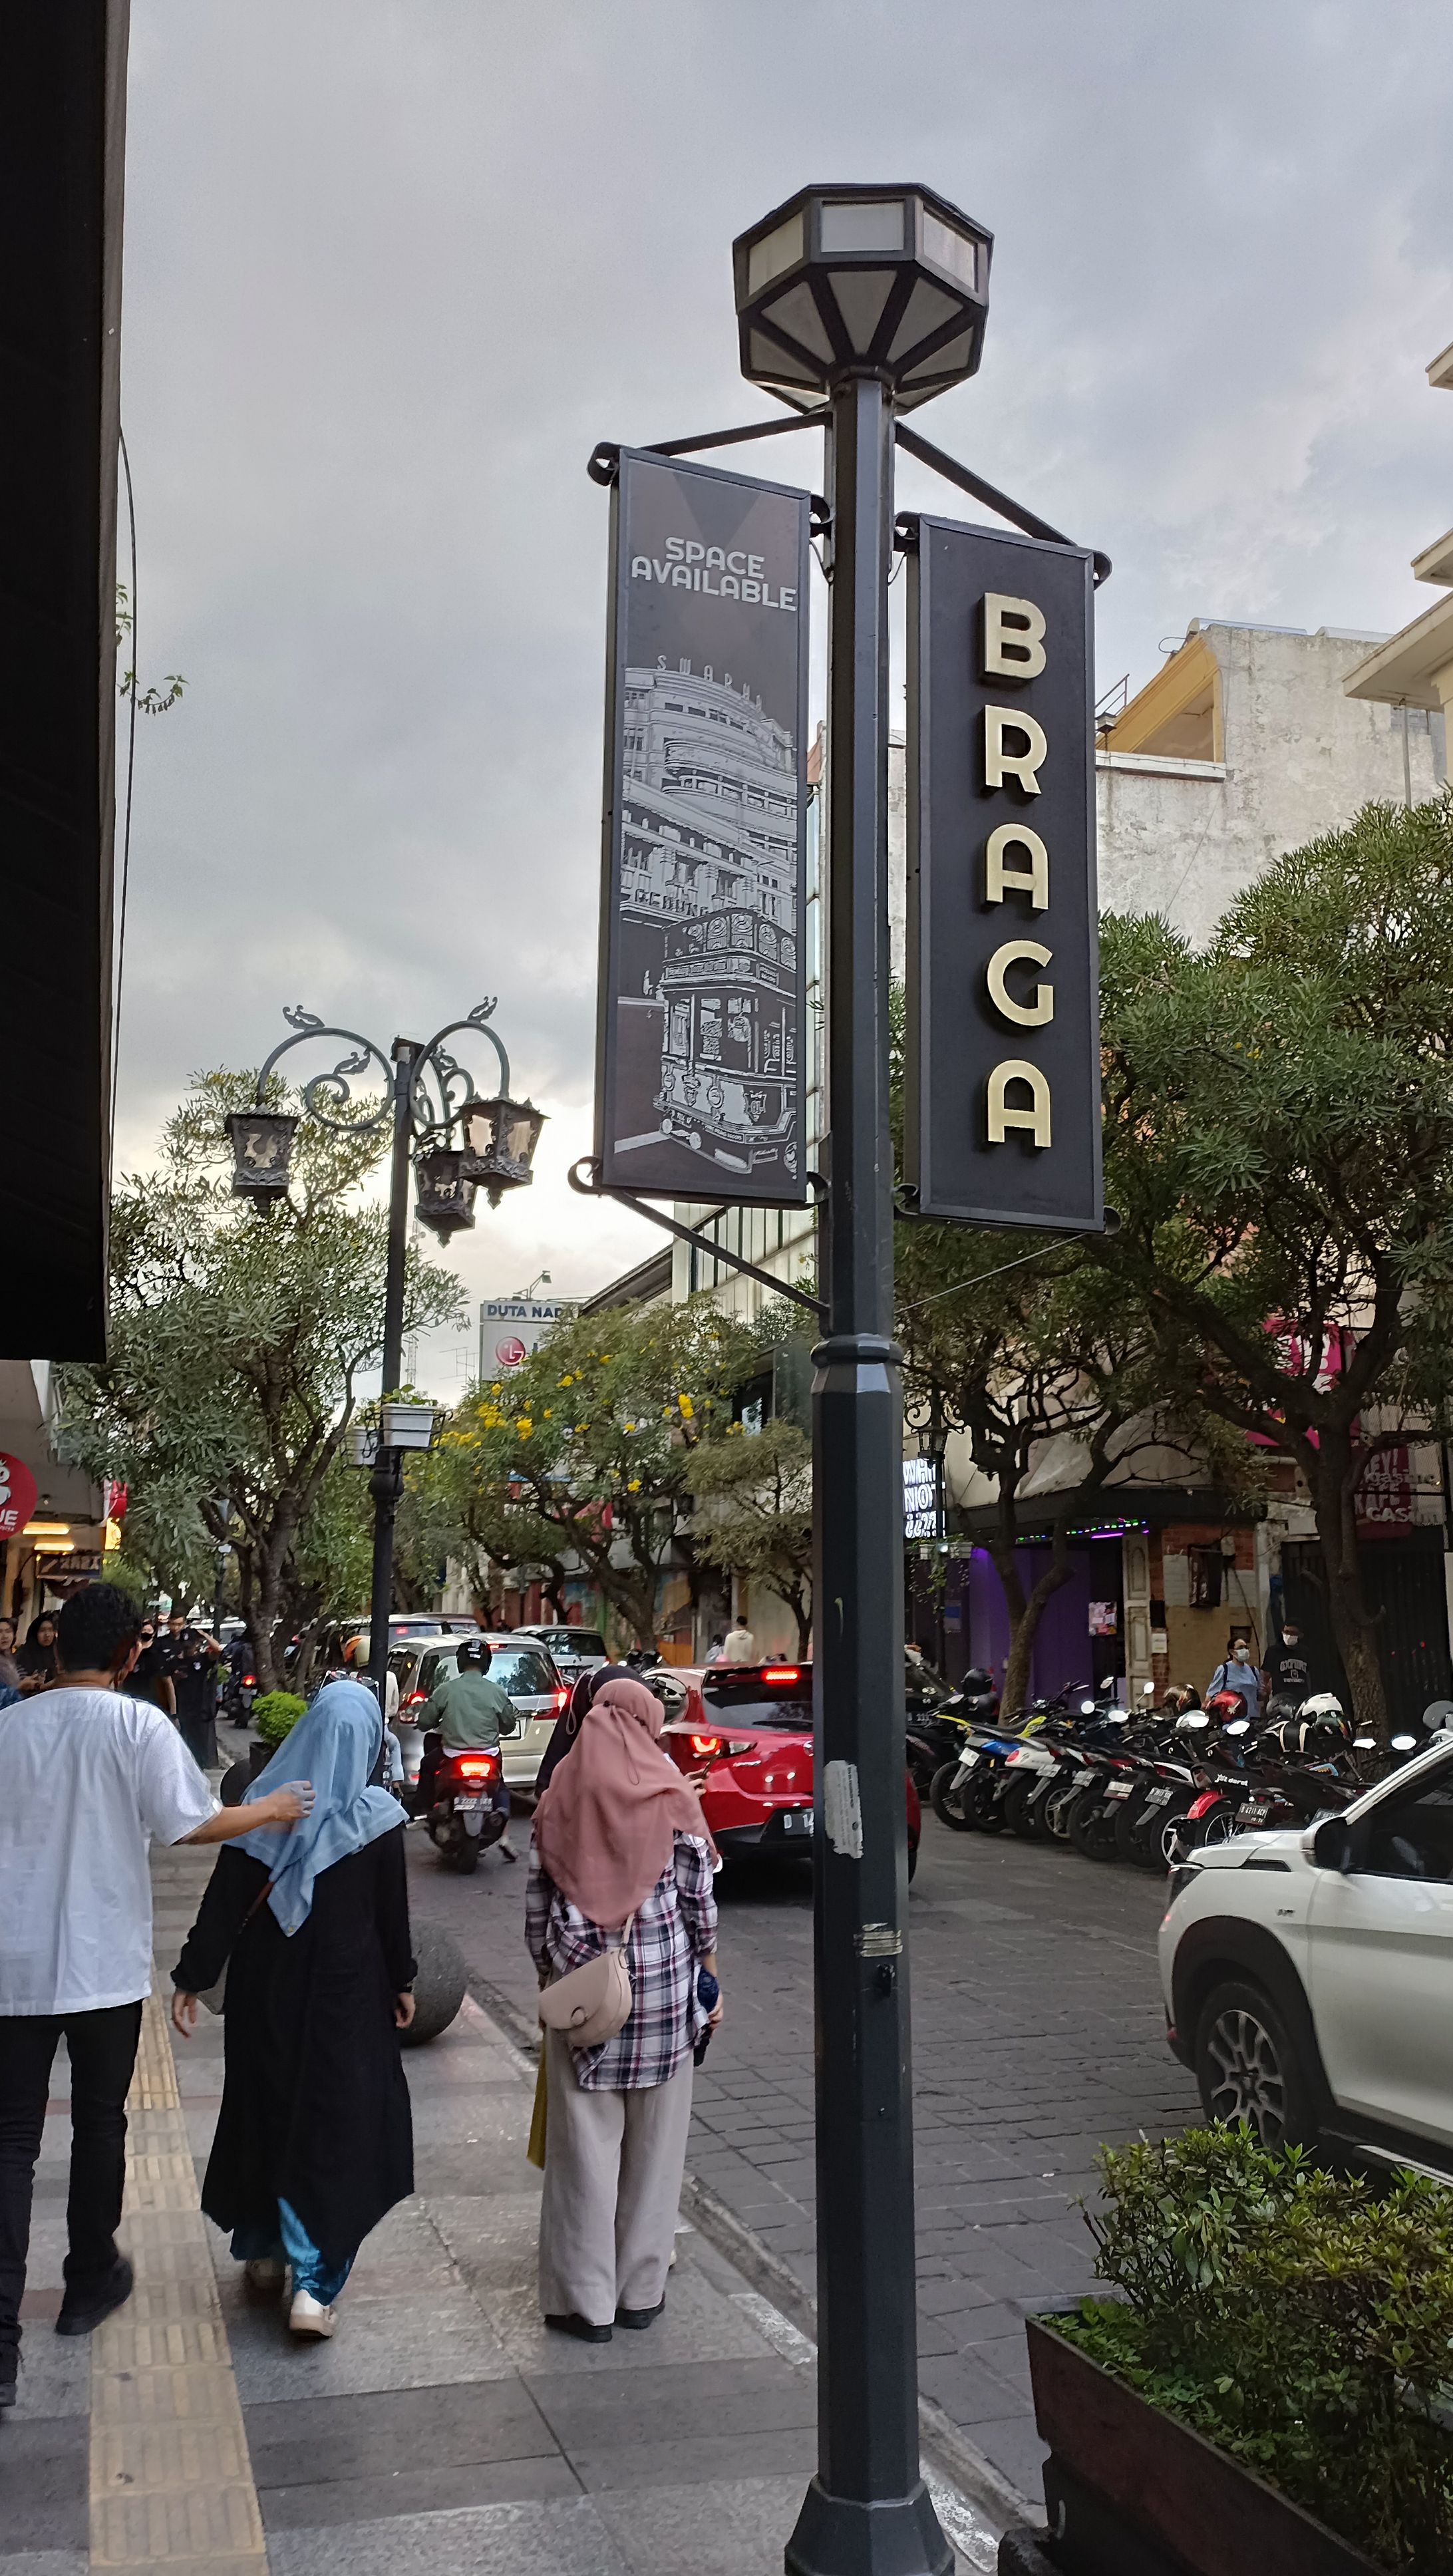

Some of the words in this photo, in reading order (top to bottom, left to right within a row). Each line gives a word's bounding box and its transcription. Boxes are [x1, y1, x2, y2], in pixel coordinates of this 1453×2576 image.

[665, 537, 765, 579] SPACE
[631, 556, 798, 611] AVAILABLE
[983, 592, 1054, 1148] BRAGA
[488, 1305, 527, 1317] DUTA
